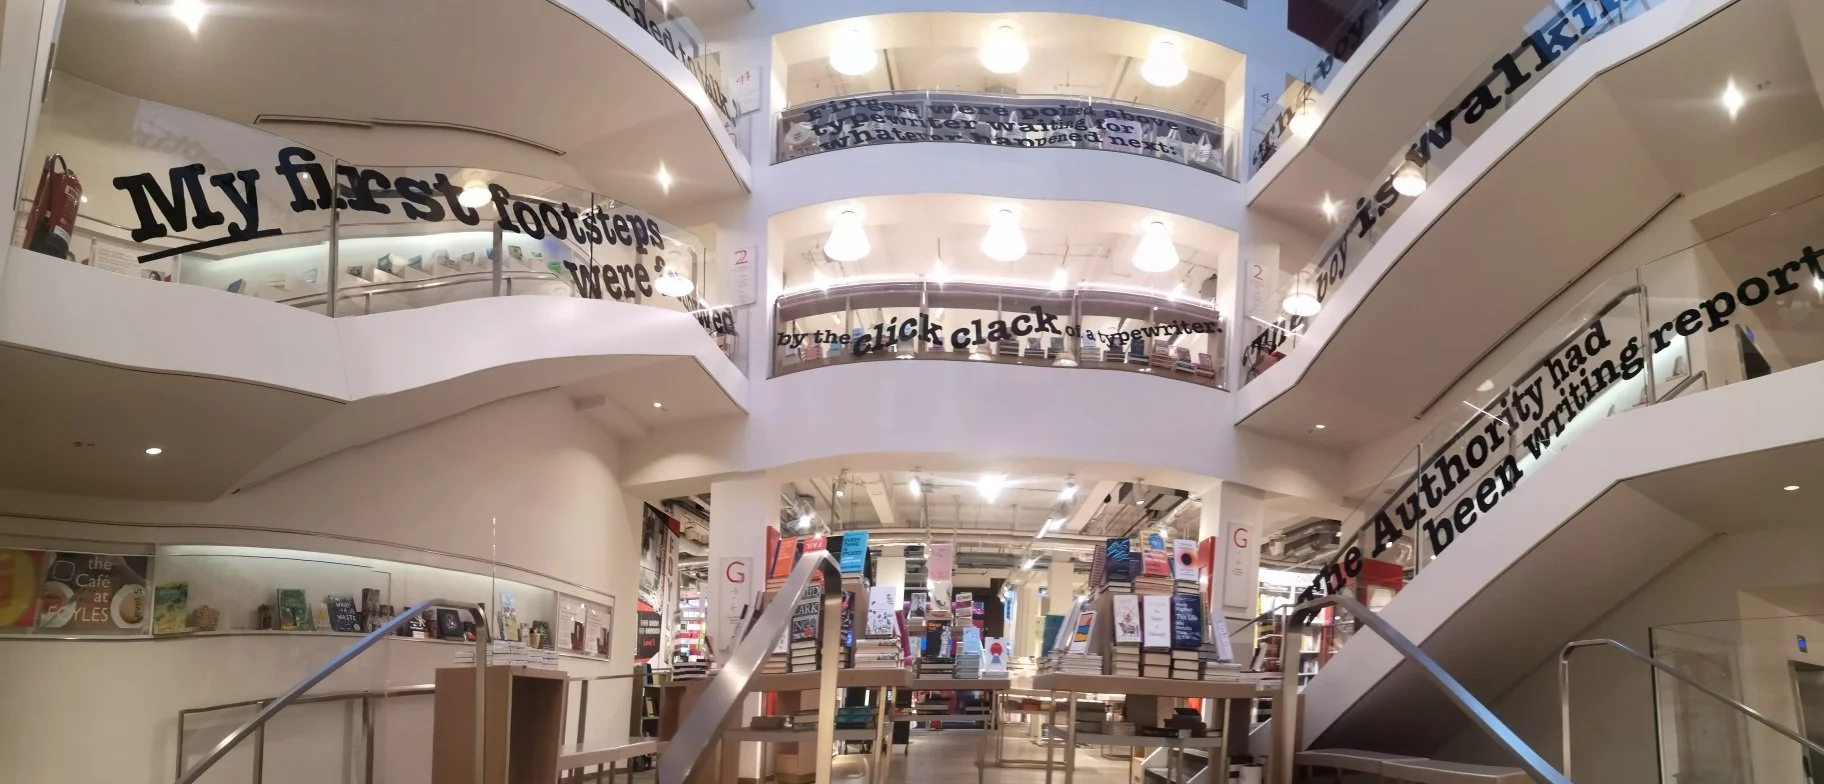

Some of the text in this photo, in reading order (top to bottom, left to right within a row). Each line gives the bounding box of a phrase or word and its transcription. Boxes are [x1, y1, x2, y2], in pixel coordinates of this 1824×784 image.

[804, 98, 1199, 137] Fingers were poised above a
[811, 112, 1134, 137] typewriter waiting for
[819, 127, 1177, 155] whatever happened next:
[113, 146, 665, 254] My first footsteps
[1356, 174, 1400, 239] is
[735, 250, 748, 265] 2
[563, 257, 653, 301] were
[1253, 265, 1264, 280] 2
[777, 304, 1223, 357] by the click clack of a typewriter.
[1372, 377, 1545, 558] Authority
[1544, 319, 1612, 390] had
[1423, 453, 1524, 557] been
[1522, 336, 1645, 461] writing
[1233, 527, 1248, 548] G
[88, 556, 112, 570] the
[726, 561, 745, 583] G
[75, 573, 111, 589] Café
[94, 590, 109, 603] at
[47, 605, 109, 622] FOYLES
